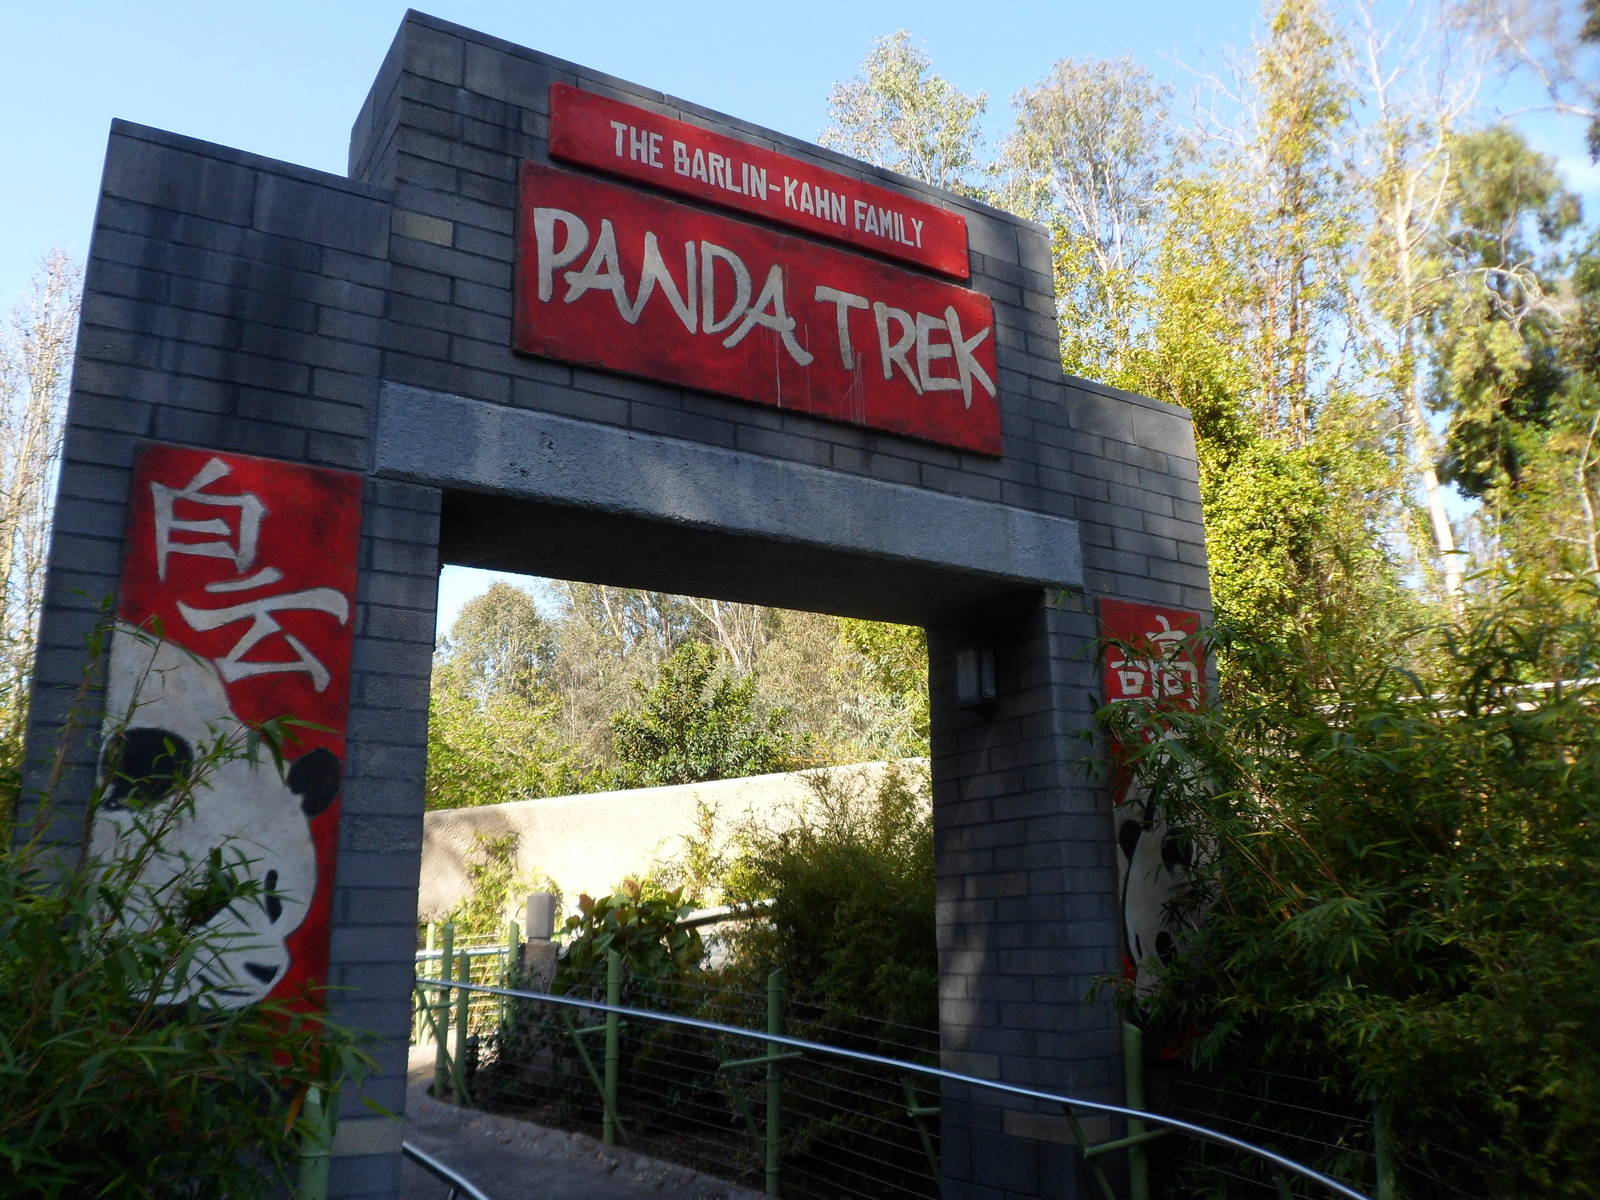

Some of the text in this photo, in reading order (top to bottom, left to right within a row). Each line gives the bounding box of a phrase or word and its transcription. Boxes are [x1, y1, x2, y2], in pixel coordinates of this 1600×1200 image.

[610, 120, 924, 249] THE BARLIN-KAHN FAMILY
[533, 207, 996, 409] PANDA TREK
